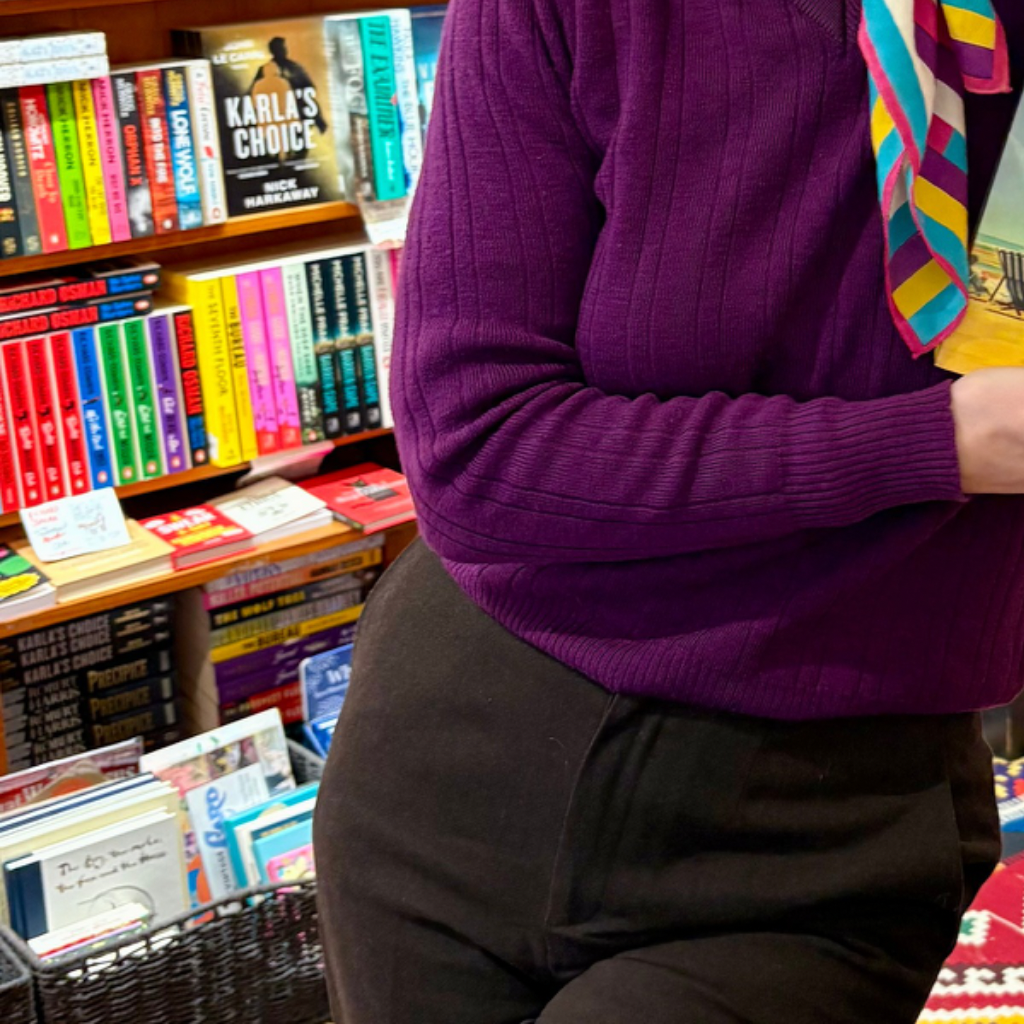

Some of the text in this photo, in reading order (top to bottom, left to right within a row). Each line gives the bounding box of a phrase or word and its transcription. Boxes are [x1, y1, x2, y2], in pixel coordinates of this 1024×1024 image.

[368, 22, 395, 139] THE EXAMINER
[23, 98, 44, 161] HOROWITZ
[79, 82, 98, 167] MICK HERRON
[98, 79, 116, 165] MICK HERRON
[225, 86, 319, 129] KARLA'S
[60, 118, 75, 170] HERRON
[124, 124, 142, 186] ORPHAN X
[149, 117, 168, 183] INTO THE FIRE
[170, 109, 196, 195] LONE WOLF
[233, 119, 318, 160] CHOICE
[244, 187, 319, 208] HARKAWAY
[263, 178, 297, 192] NICK
[58, 279, 107, 302] OSMAN
[50, 306, 98, 330] OSMAN
[207, 301, 223, 356] SEVENTH
[311, 263, 327, 314] MICHELLE
[323, 390, 338, 414] CAPE
[332, 259, 348, 310] MICHELLE
[344, 385, 359, 409] CAPE
[352, 256, 368, 305] MICHELLE
[364, 381, 379, 404] CAPE
[175, 313, 203, 416] RICHARD OSMAN
[229, 322, 247, 370] BUREAU
[213, 357, 229, 396] FLOOR
[17, 613, 111, 652] KARLA'S CHOICE
[214, 609, 239, 625] THE
[240, 599, 275, 618] WOLF
[20, 627, 112, 667] KARLA'S CHOICE
[23, 644, 114, 684] KARLA'S CHOICE
[87, 659, 148, 694] PRECIPICE
[90, 686, 150, 721] PRECIPICE
